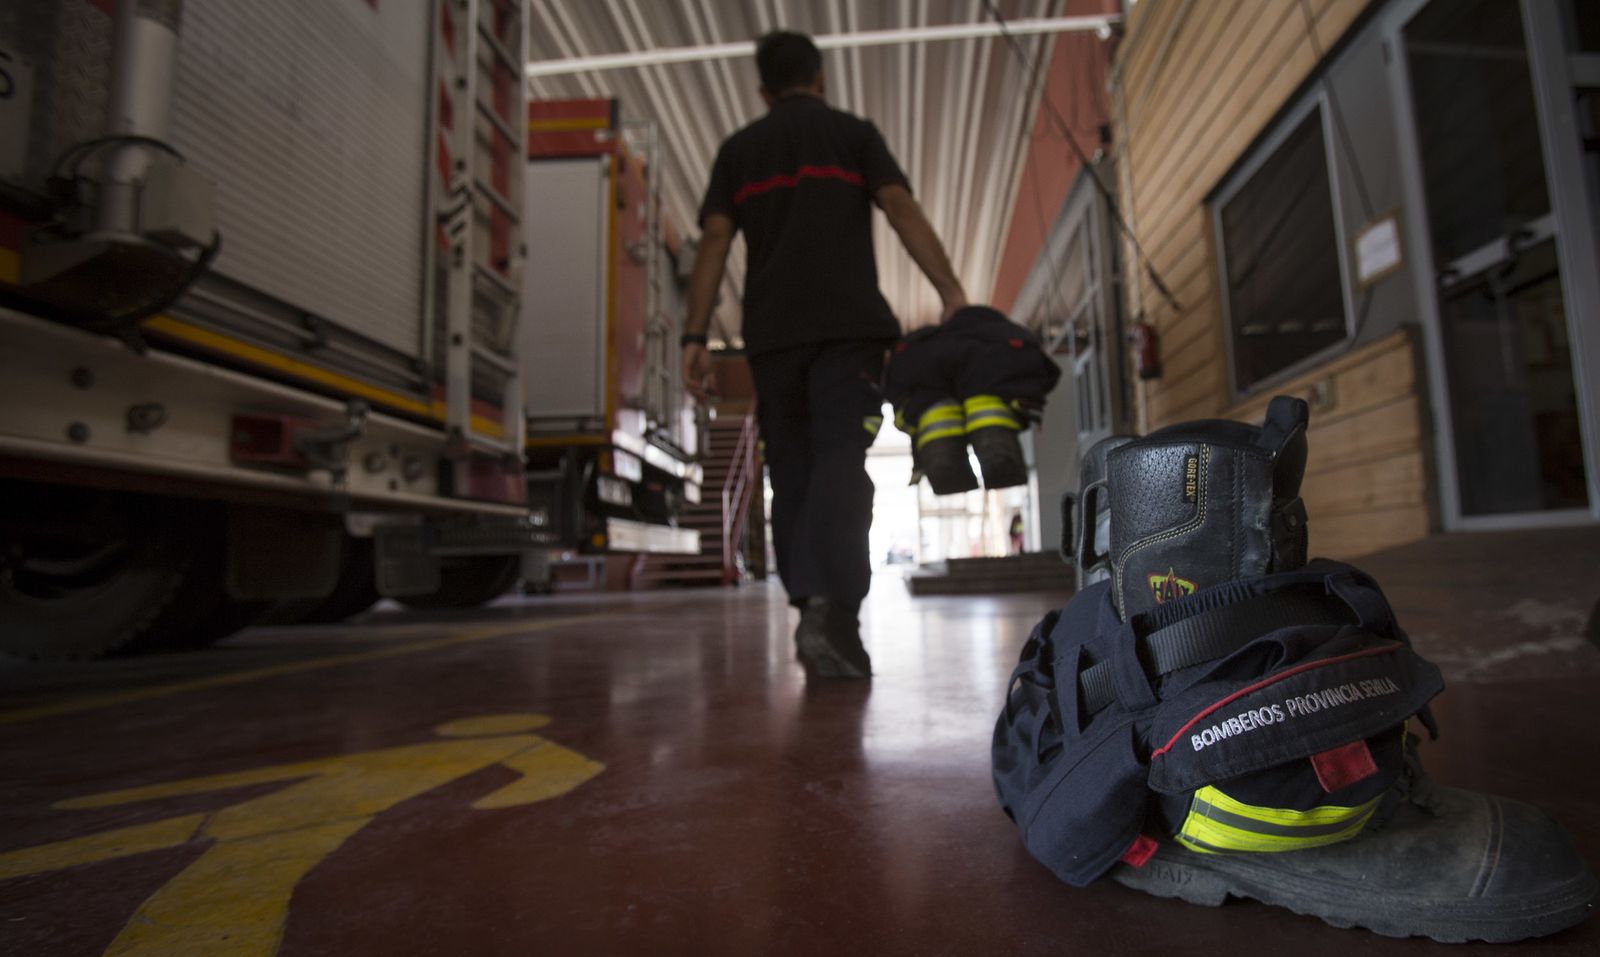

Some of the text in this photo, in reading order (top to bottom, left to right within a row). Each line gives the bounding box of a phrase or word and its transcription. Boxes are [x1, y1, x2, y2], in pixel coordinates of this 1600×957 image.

[1186, 457, 1197, 496] GORE-TEX
[1191, 704, 1285, 752] BOMBEROS
[1286, 684, 1363, 717] PROVINCIA
